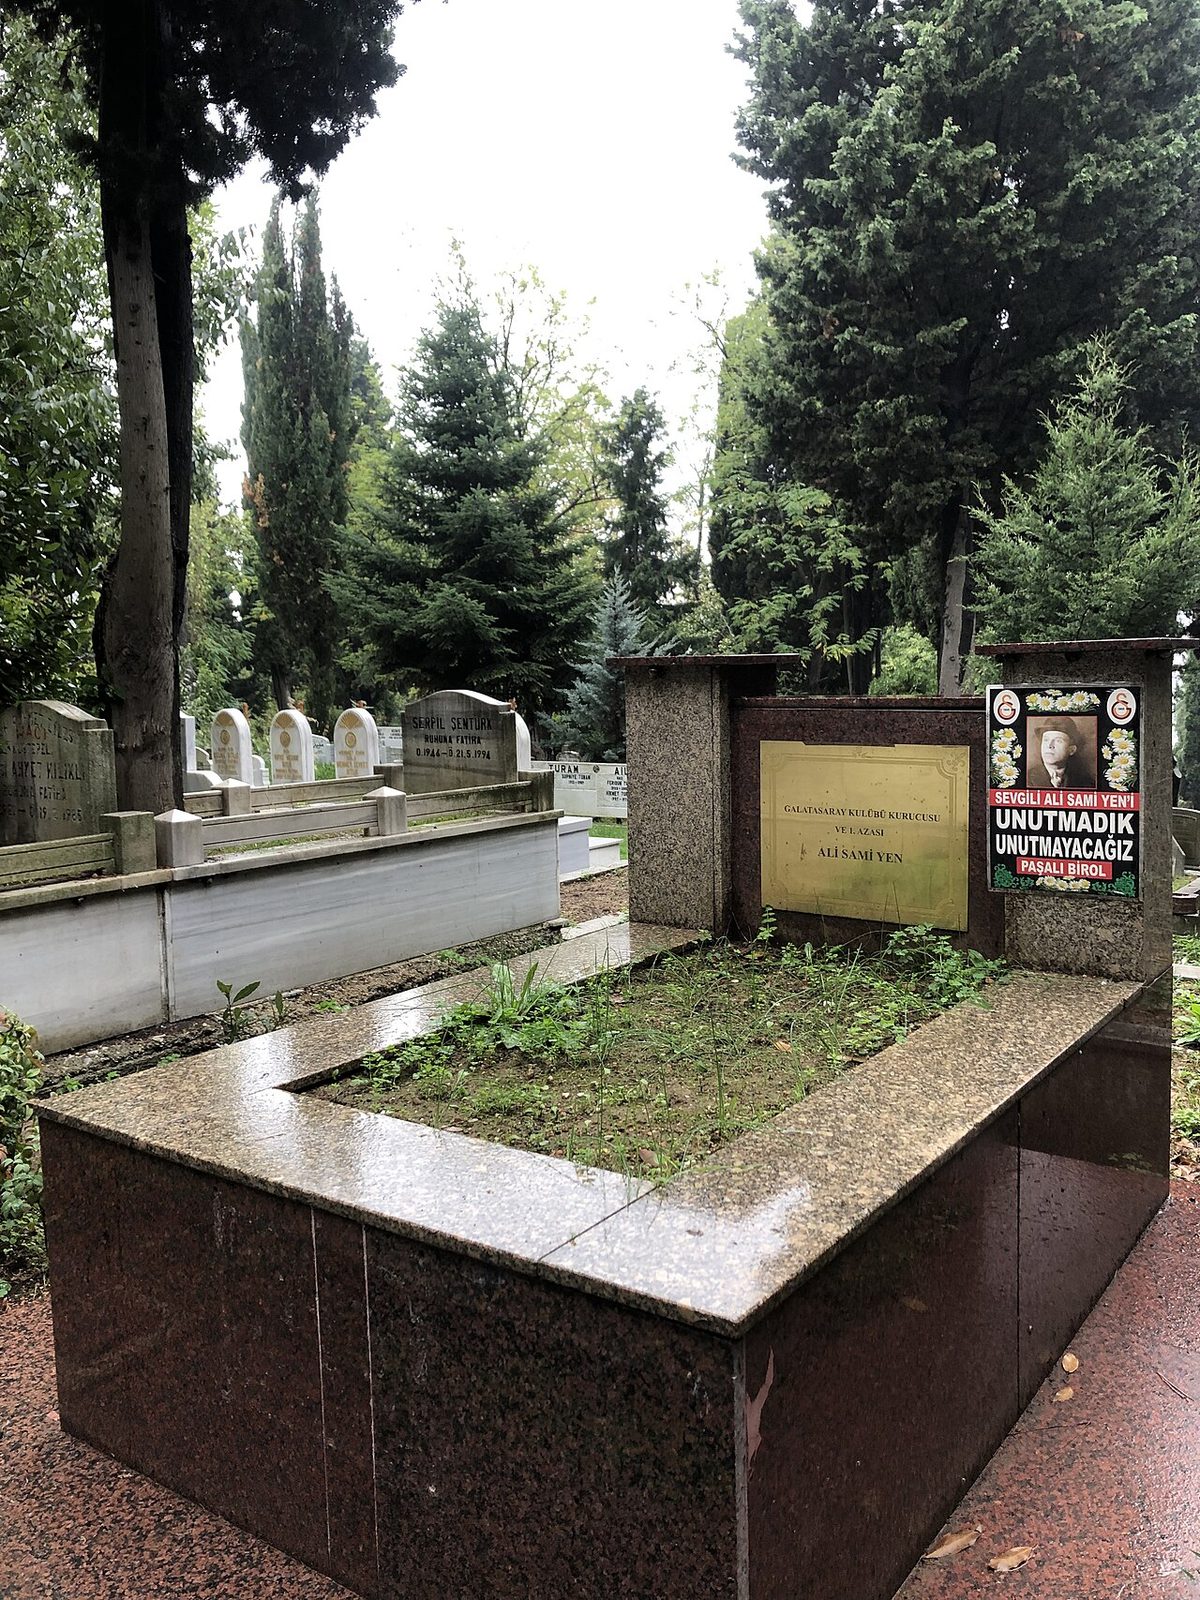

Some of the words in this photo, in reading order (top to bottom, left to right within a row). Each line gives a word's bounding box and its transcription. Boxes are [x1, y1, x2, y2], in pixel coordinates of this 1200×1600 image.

[424, 734, 453, 744] RUHUNA
[995, 789, 1040, 805] SEVGİLİ
[1043, 790, 1063, 806] ALİ
[1067, 791, 1097, 807] SAMİ
[1101, 793, 1134, 808] YEN'İ
[784, 805, 847, 816] GALATASARAY
[848, 808, 887, 819] KULÜBÜ
[888, 811, 941, 822] KURUCUSU
[996, 808, 1134, 835] UNUTMADIK
[835, 825, 847, 834] VE
[857, 828, 884, 837] AZASI
[818, 846, 838, 858] ALİ
[841, 848, 873, 861] SAMİ
[876, 852, 904, 864] YEN
[995, 833, 1134, 861] UNUTMAYACAĞIZ
[1021, 860, 1064, 876] PAŞALI
[1068, 860, 1107, 877] BİROL
